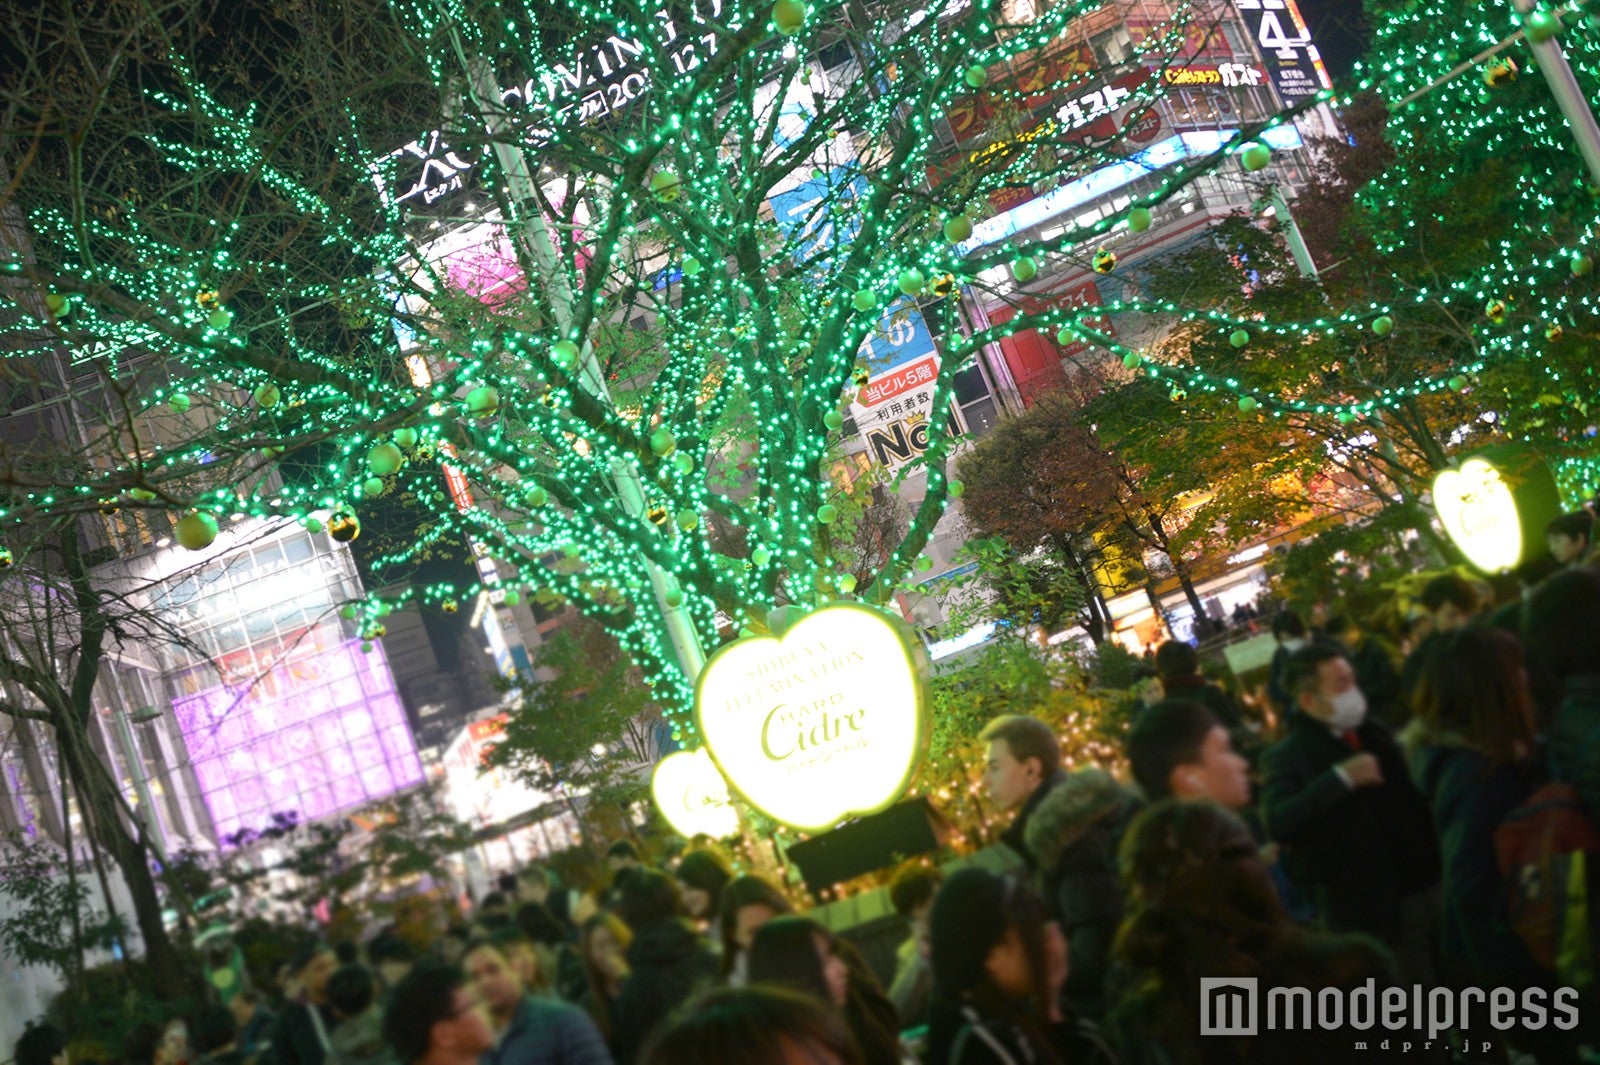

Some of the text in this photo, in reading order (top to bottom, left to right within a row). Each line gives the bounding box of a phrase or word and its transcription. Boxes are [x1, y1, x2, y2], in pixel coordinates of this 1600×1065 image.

[1217, 62, 1263, 87] ガスト
[1056, 84, 1130, 134] ガスト
[865, 363, 933, 403] 当ビル5階
[876, 390, 931, 422] 利用者数
[778, 692, 845, 726] HARD
[760, 703, 867, 763] Cidre
